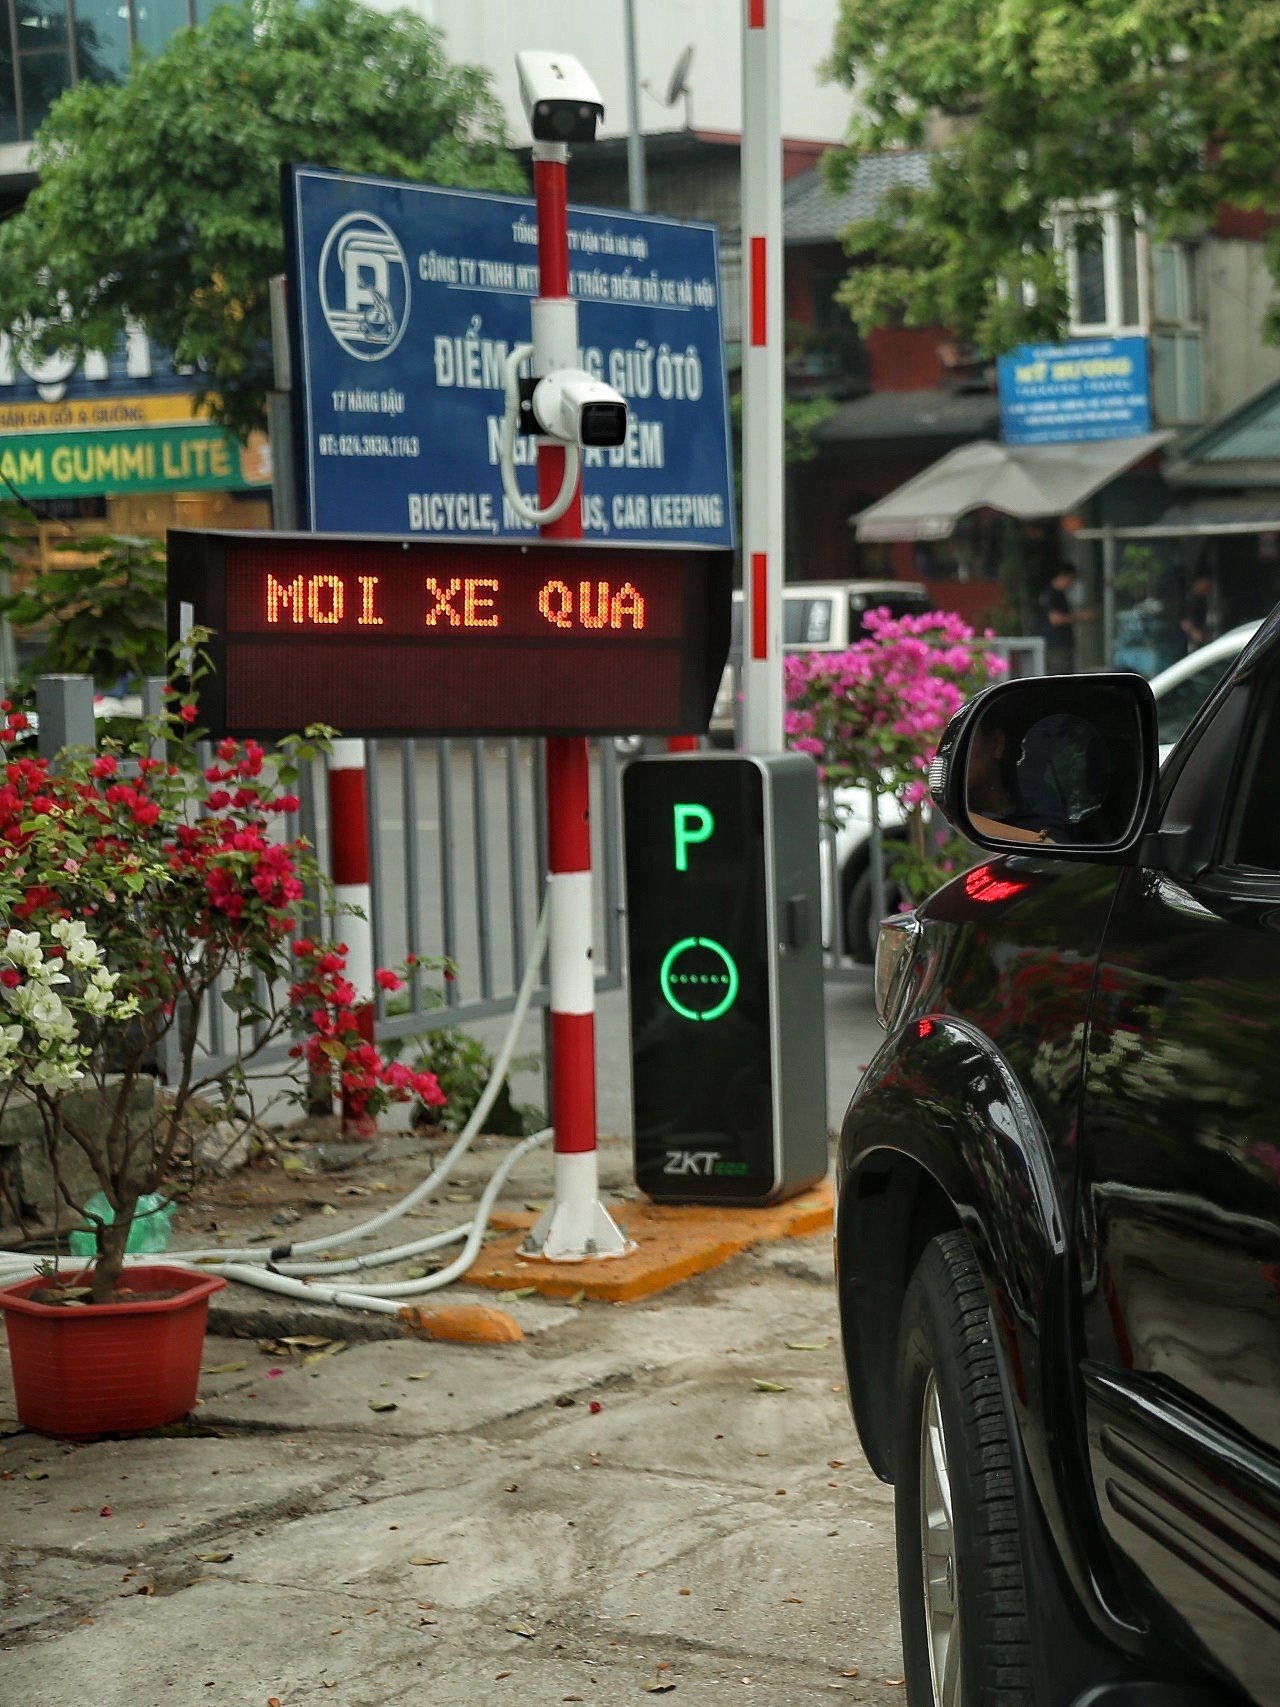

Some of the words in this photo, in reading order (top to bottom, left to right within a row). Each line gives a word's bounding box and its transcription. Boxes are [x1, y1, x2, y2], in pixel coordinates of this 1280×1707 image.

[615, 234, 629, 256] HÀ
[629, 233, 649, 262] NỘI
[418, 249, 458, 283] CÔNG
[459, 256, 477, 286] TY
[478, 260, 514, 289] TNHH
[516, 264, 540, 292] MT
[577, 266, 609, 299] THÁC
[610, 265, 641, 300] ĐIỂM
[661, 279, 677, 304] XE
[677, 277, 693, 308] HÀ
[693, 277, 716, 311] NỘI
[434, 314, 508, 391] ĐIỂM
[609, 339, 655, 399] GIỮ
[655, 343, 703, 401] ÔTÔ
[332, 390, 346, 412] 17
[347, 387, 380, 413] HÀNG
[380, 387, 406, 417] ĐẬU
[0, 447, 45, 485] AM
[52, 441, 156, 484] GUMMI
[162, 437, 231, 479] LITE
[407, 492, 498, 536] BICYCLE,
[611, 493, 650, 530] CAR
[650, 493, 724, 529] KEEPING
[266, 573, 384, 626] MOI
[425, 577, 499, 628] XE
[537, 580, 645, 630] QUA
[672, 803, 715, 872] P
